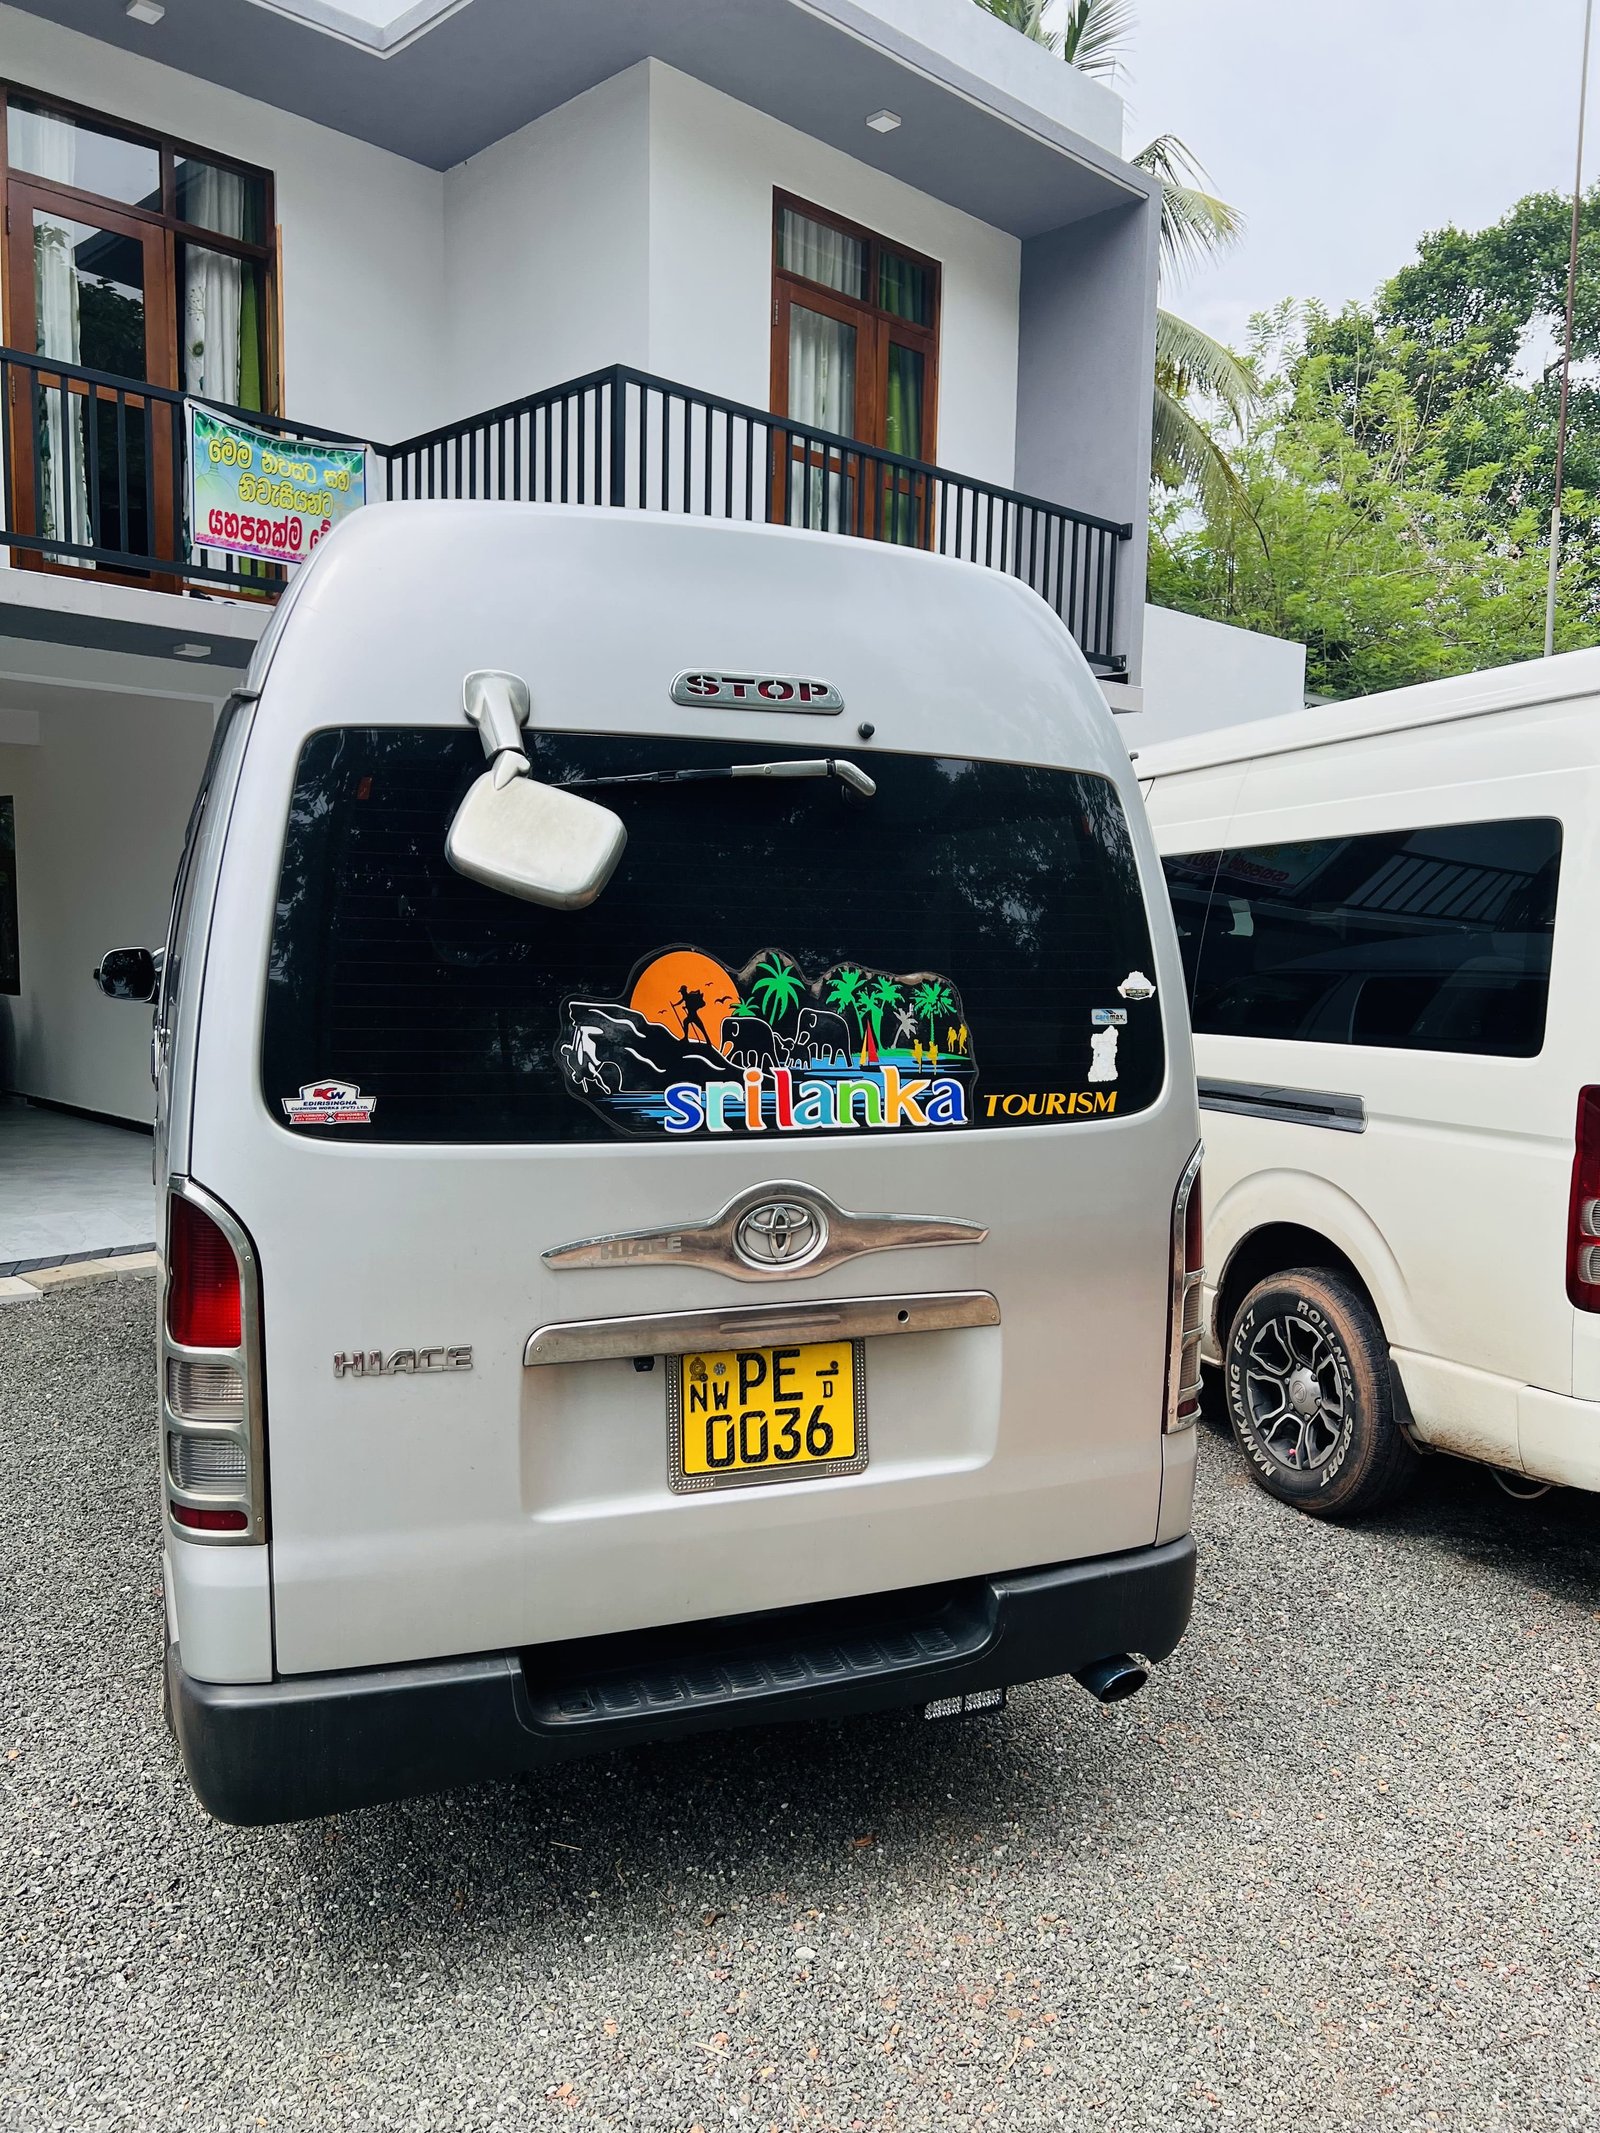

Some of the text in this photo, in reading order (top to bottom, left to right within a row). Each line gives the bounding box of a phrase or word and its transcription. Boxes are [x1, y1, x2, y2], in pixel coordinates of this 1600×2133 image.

[208, 437, 254, 469] මෙම
[685, 675, 829, 703] STOP
[984, 1091, 1118, 1117] TOURISM
[600, 1237, 682, 1260] HIACE
[333, 1344, 474, 1378] HIACE
[735, 1348, 804, 1405] PE
[690, 1380, 730, 1413] NW
[822, 1380, 834, 1398] D
[1296, 1300, 1355, 1487] ROLLNEX SPORT
[706, 1405, 834, 1468] 0036
[1230, 1364, 1278, 1477] NANKANG
